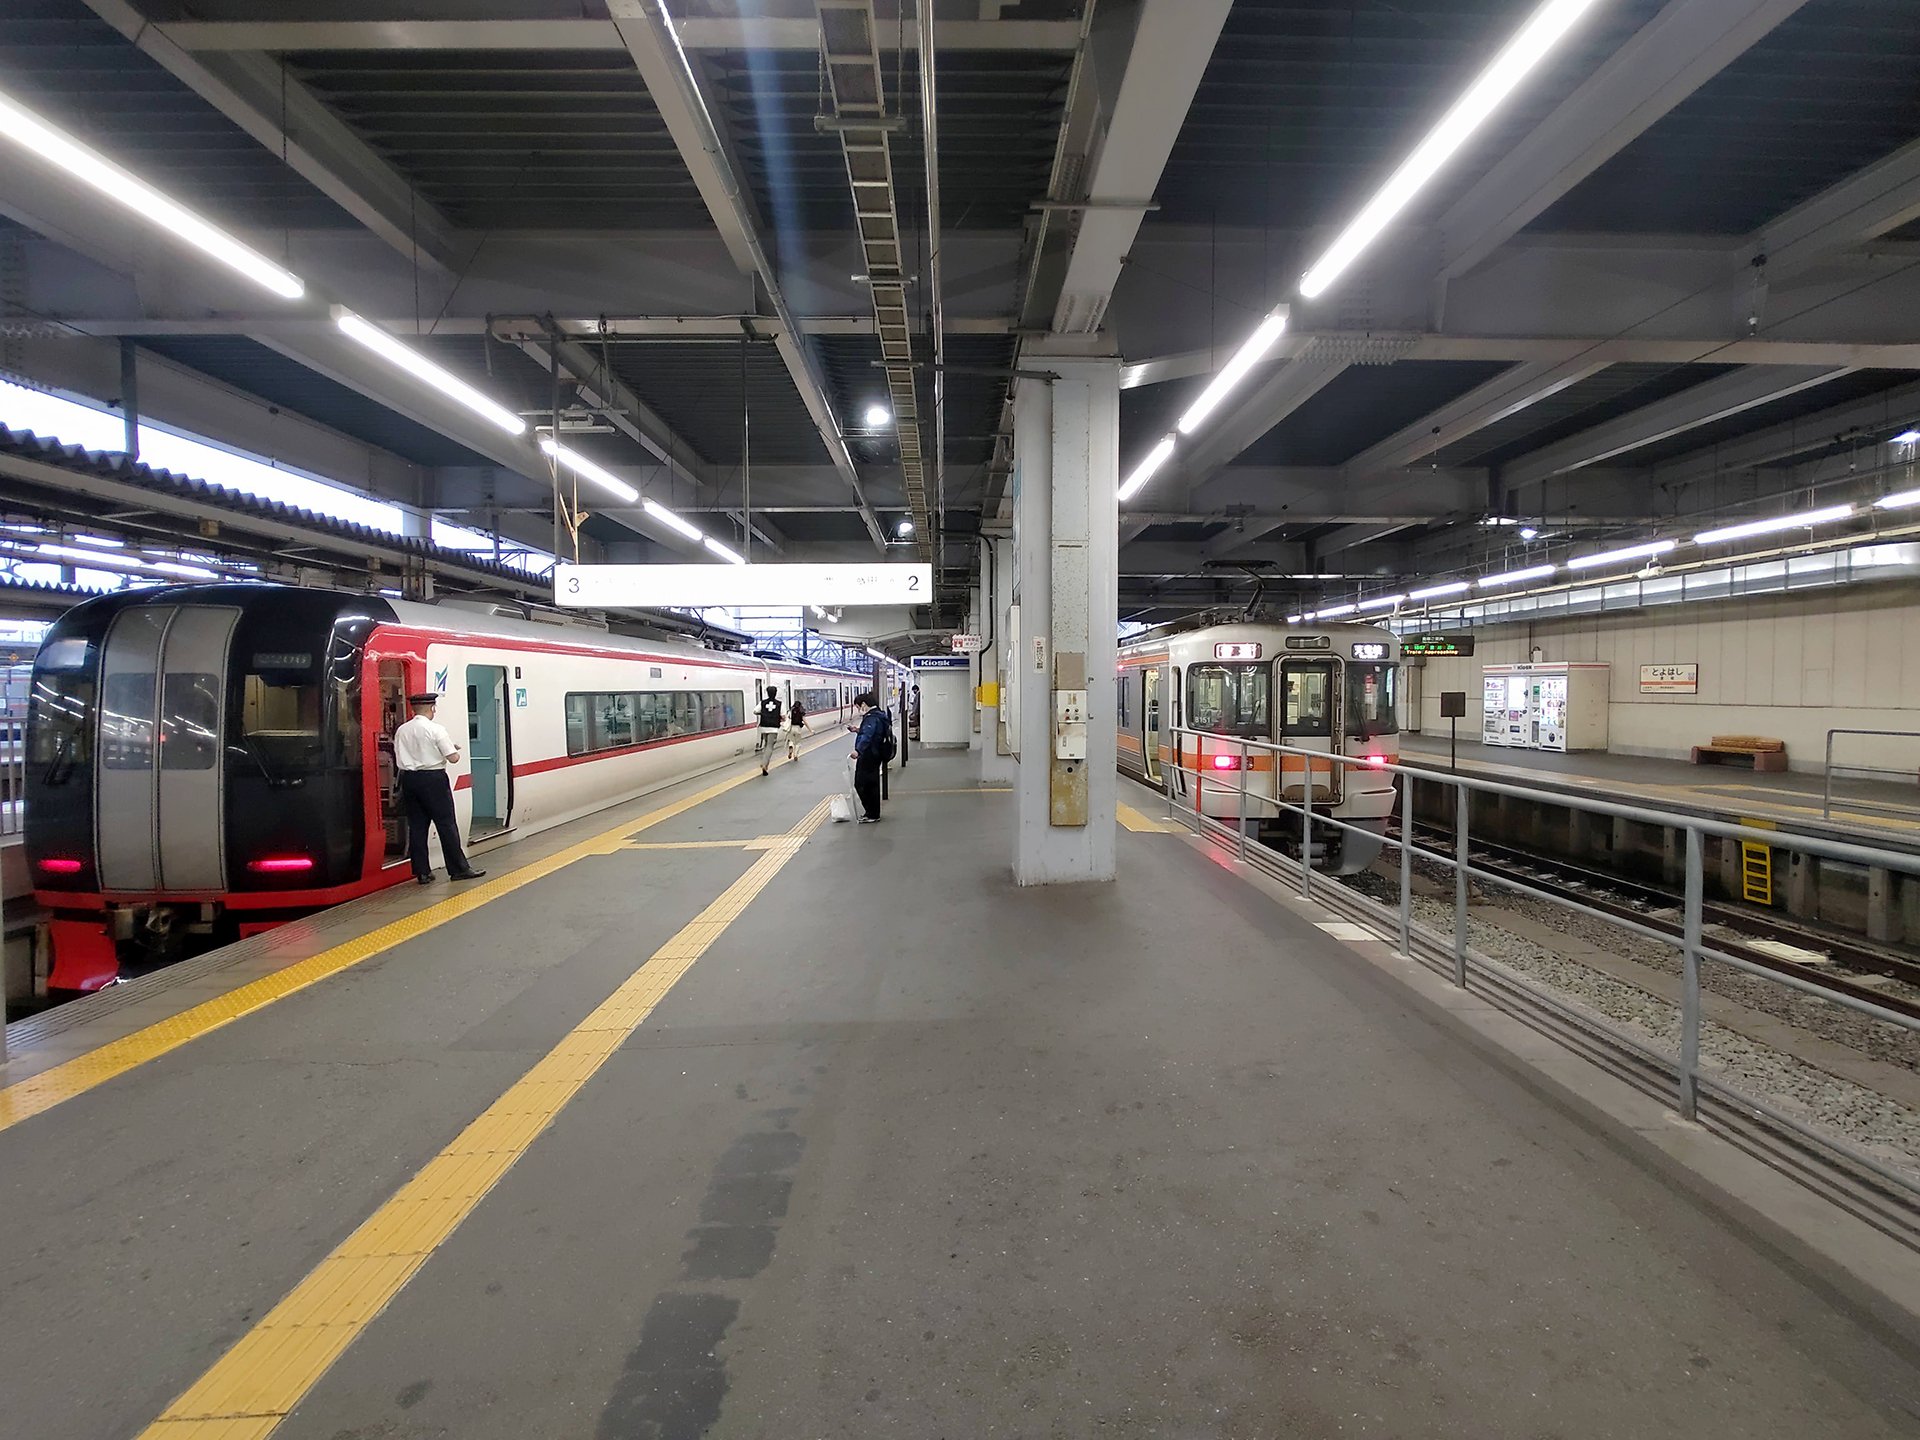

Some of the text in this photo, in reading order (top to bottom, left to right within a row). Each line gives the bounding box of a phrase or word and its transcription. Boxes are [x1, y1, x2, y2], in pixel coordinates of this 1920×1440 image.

[568, 577, 580, 594] 3
[908, 575, 919, 591] 2
[1651, 667, 1684, 677] とよはし
